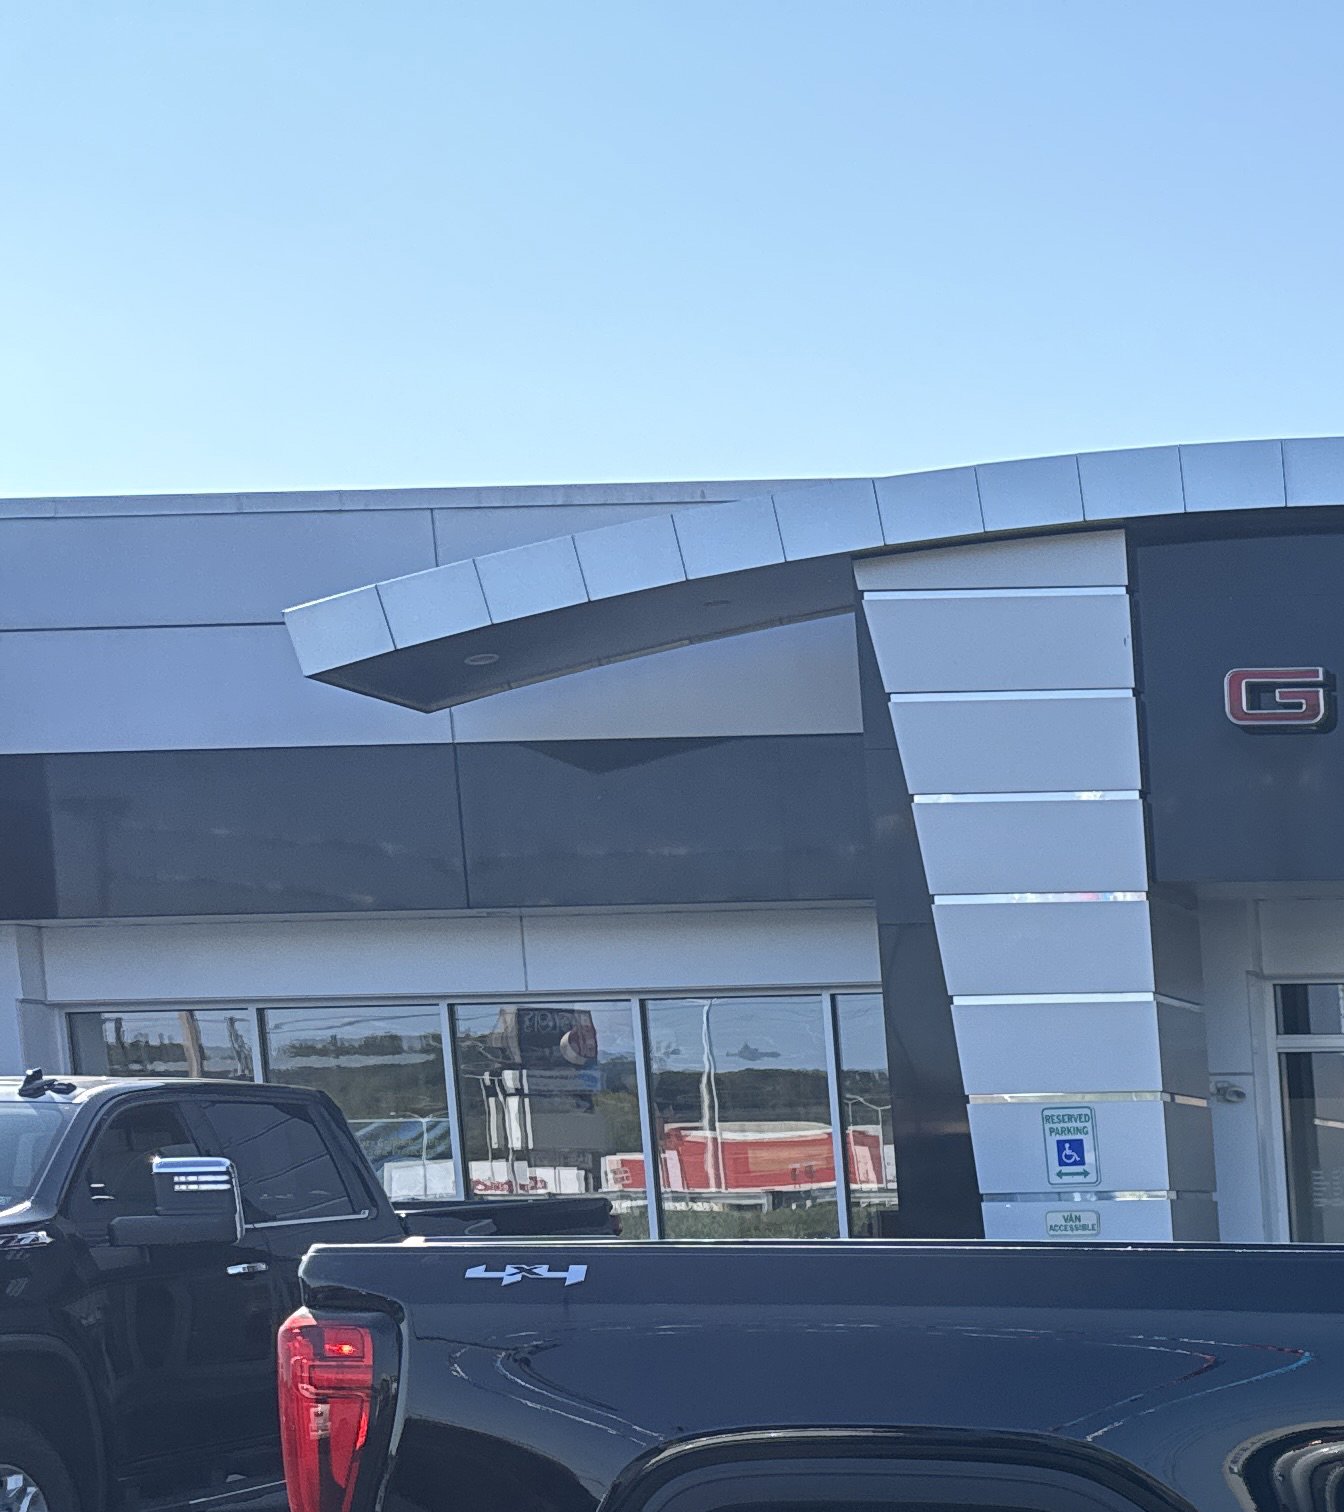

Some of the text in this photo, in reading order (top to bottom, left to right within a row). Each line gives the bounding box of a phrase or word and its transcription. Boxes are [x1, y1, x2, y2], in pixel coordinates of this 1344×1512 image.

[1044, 1113, 1090, 1124] RESERVED
[1049, 1125, 1089, 1136] PARKING
[1062, 1213, 1082, 1223] VAN
[1049, 1223, 1097, 1232] ACCESSIBLE
